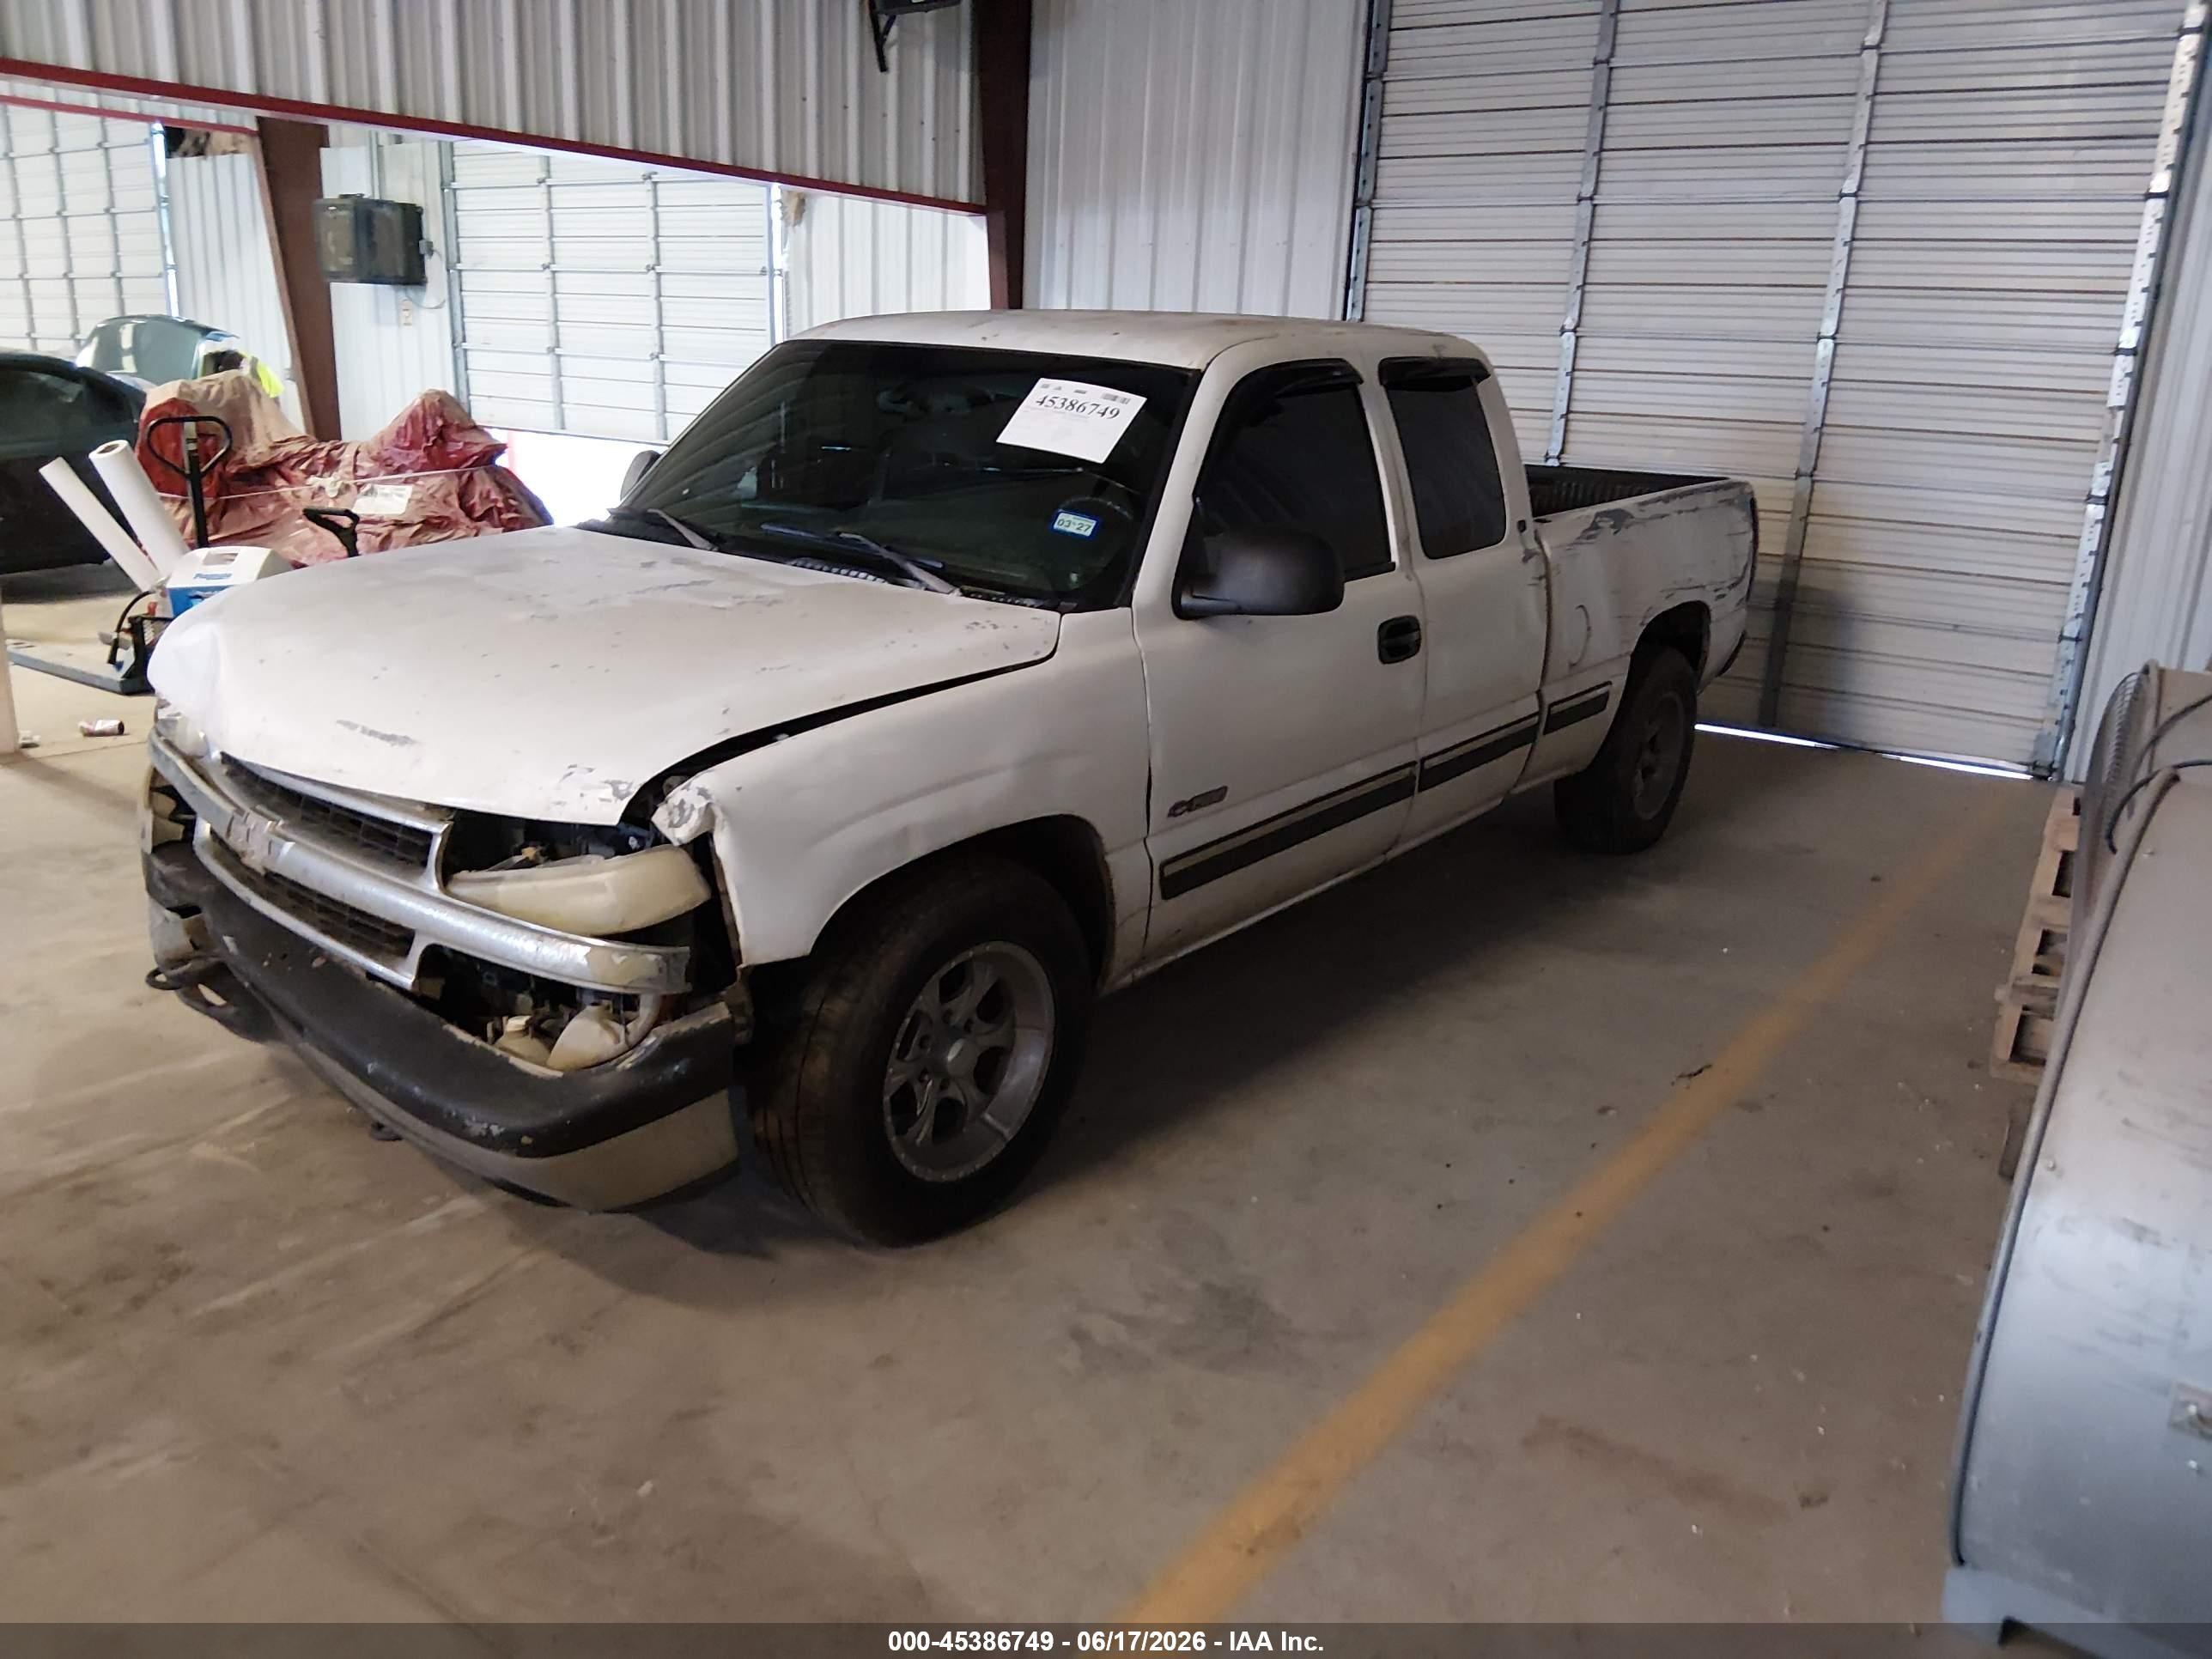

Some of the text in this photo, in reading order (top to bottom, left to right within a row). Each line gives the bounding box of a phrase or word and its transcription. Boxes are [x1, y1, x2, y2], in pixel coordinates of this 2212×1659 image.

[1036, 394, 1121, 420] 45386749
[1057, 519, 1092, 532] 03 27
